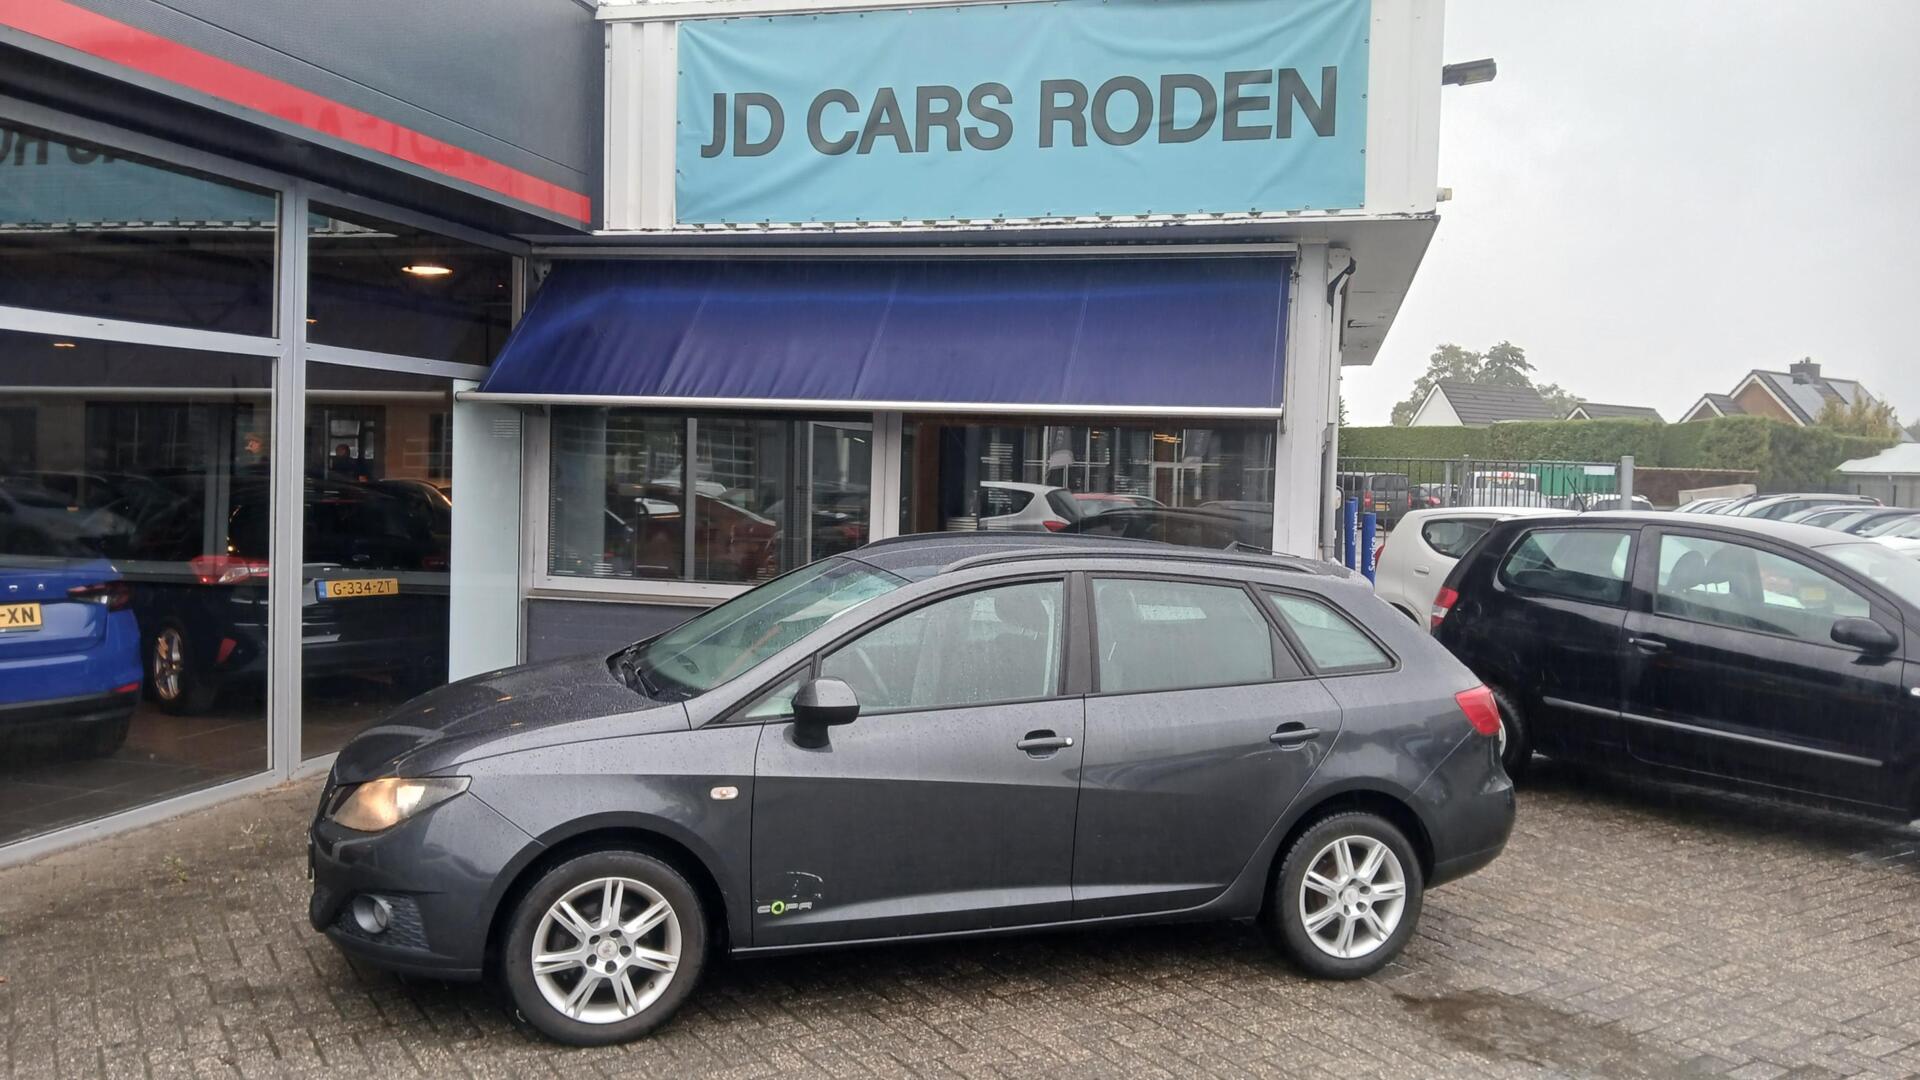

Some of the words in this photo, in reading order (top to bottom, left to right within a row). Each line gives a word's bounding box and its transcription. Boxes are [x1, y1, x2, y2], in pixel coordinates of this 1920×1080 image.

[701, 92, 785, 158] JD
[806, 82, 1014, 155] CARS
[1038, 66, 1338, 148] RODEN
[332, 580, 392, 596] G-334-ZT
